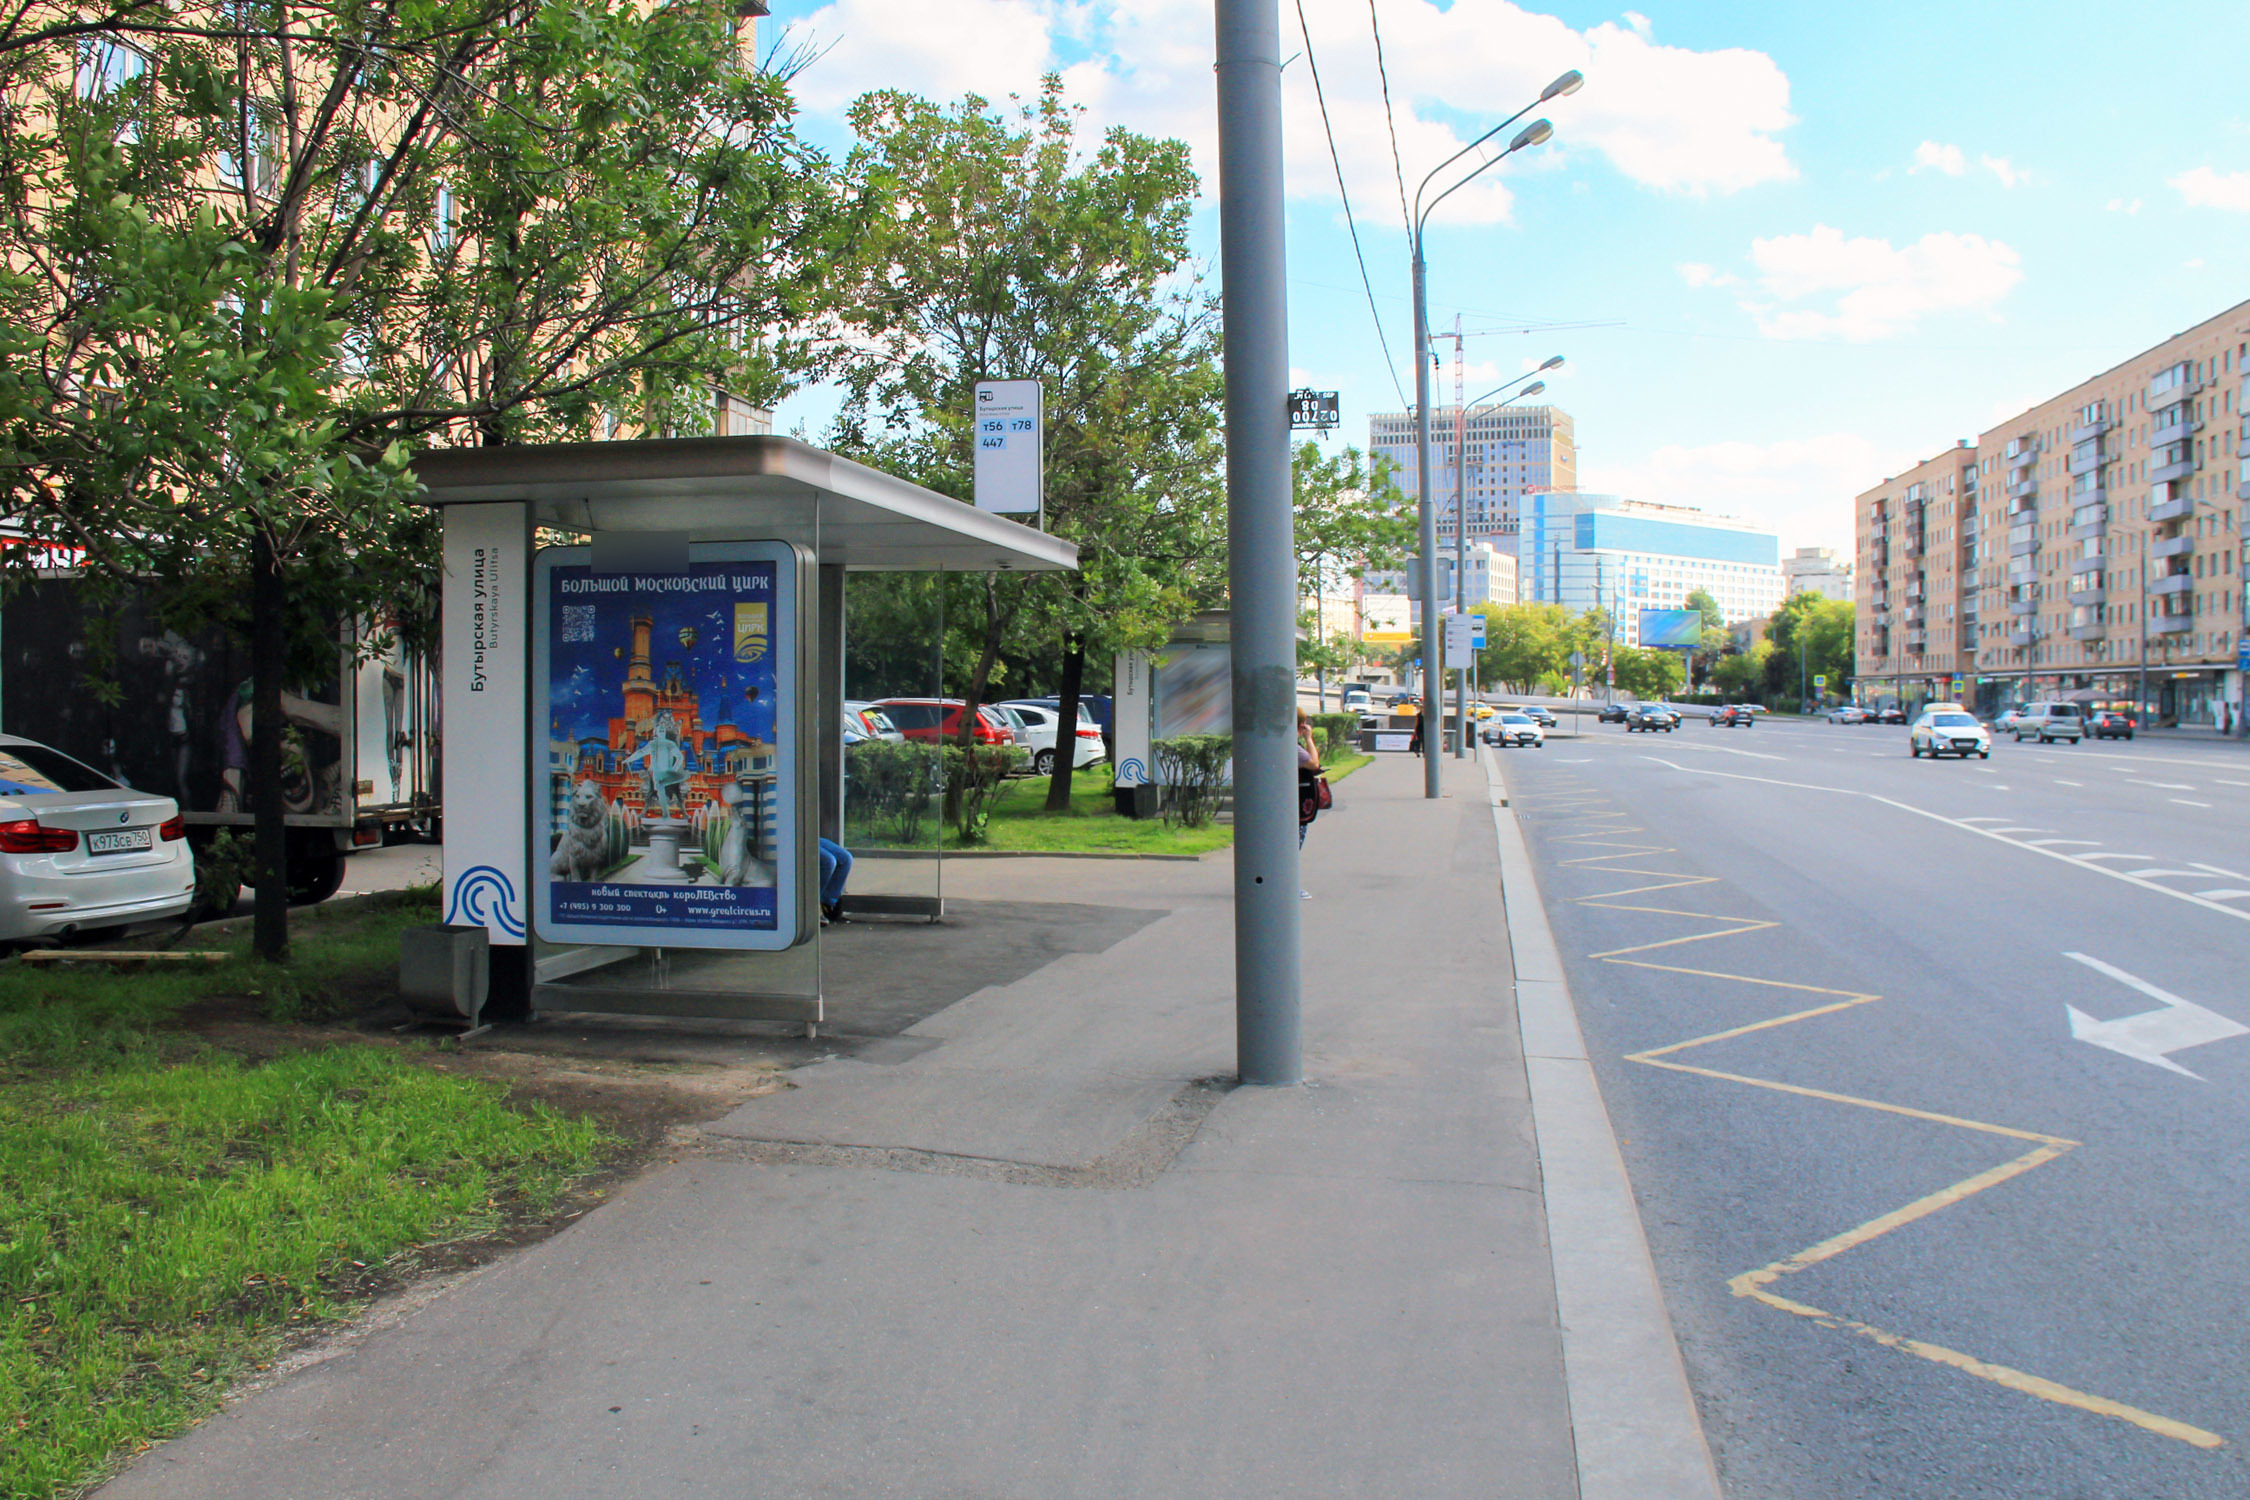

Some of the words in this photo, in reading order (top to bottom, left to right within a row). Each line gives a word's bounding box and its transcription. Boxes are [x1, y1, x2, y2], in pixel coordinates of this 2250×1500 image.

[983, 438, 1003, 448] 447
[489, 547, 498, 582] Ulitsa
[473, 548, 487, 598] улица
[635, 574, 727, 592] МОСКОВСКИЙ
[732, 575, 769, 593] ЦИРК
[489, 585, 500, 649] Butyrskaya
[737, 623, 765, 634] ЦИРК
[470, 603, 486, 692] Бутырская
[591, 886, 621, 897] новый
[623, 888, 670, 900] спектакль
[559, 902, 568, 910] +7
[569, 902, 589, 911] (495)
[591, 903, 597, 911] 9
[599, 903, 614, 911] 300
[616, 903, 632, 912] 300
[655, 904, 668, 914] 0+
